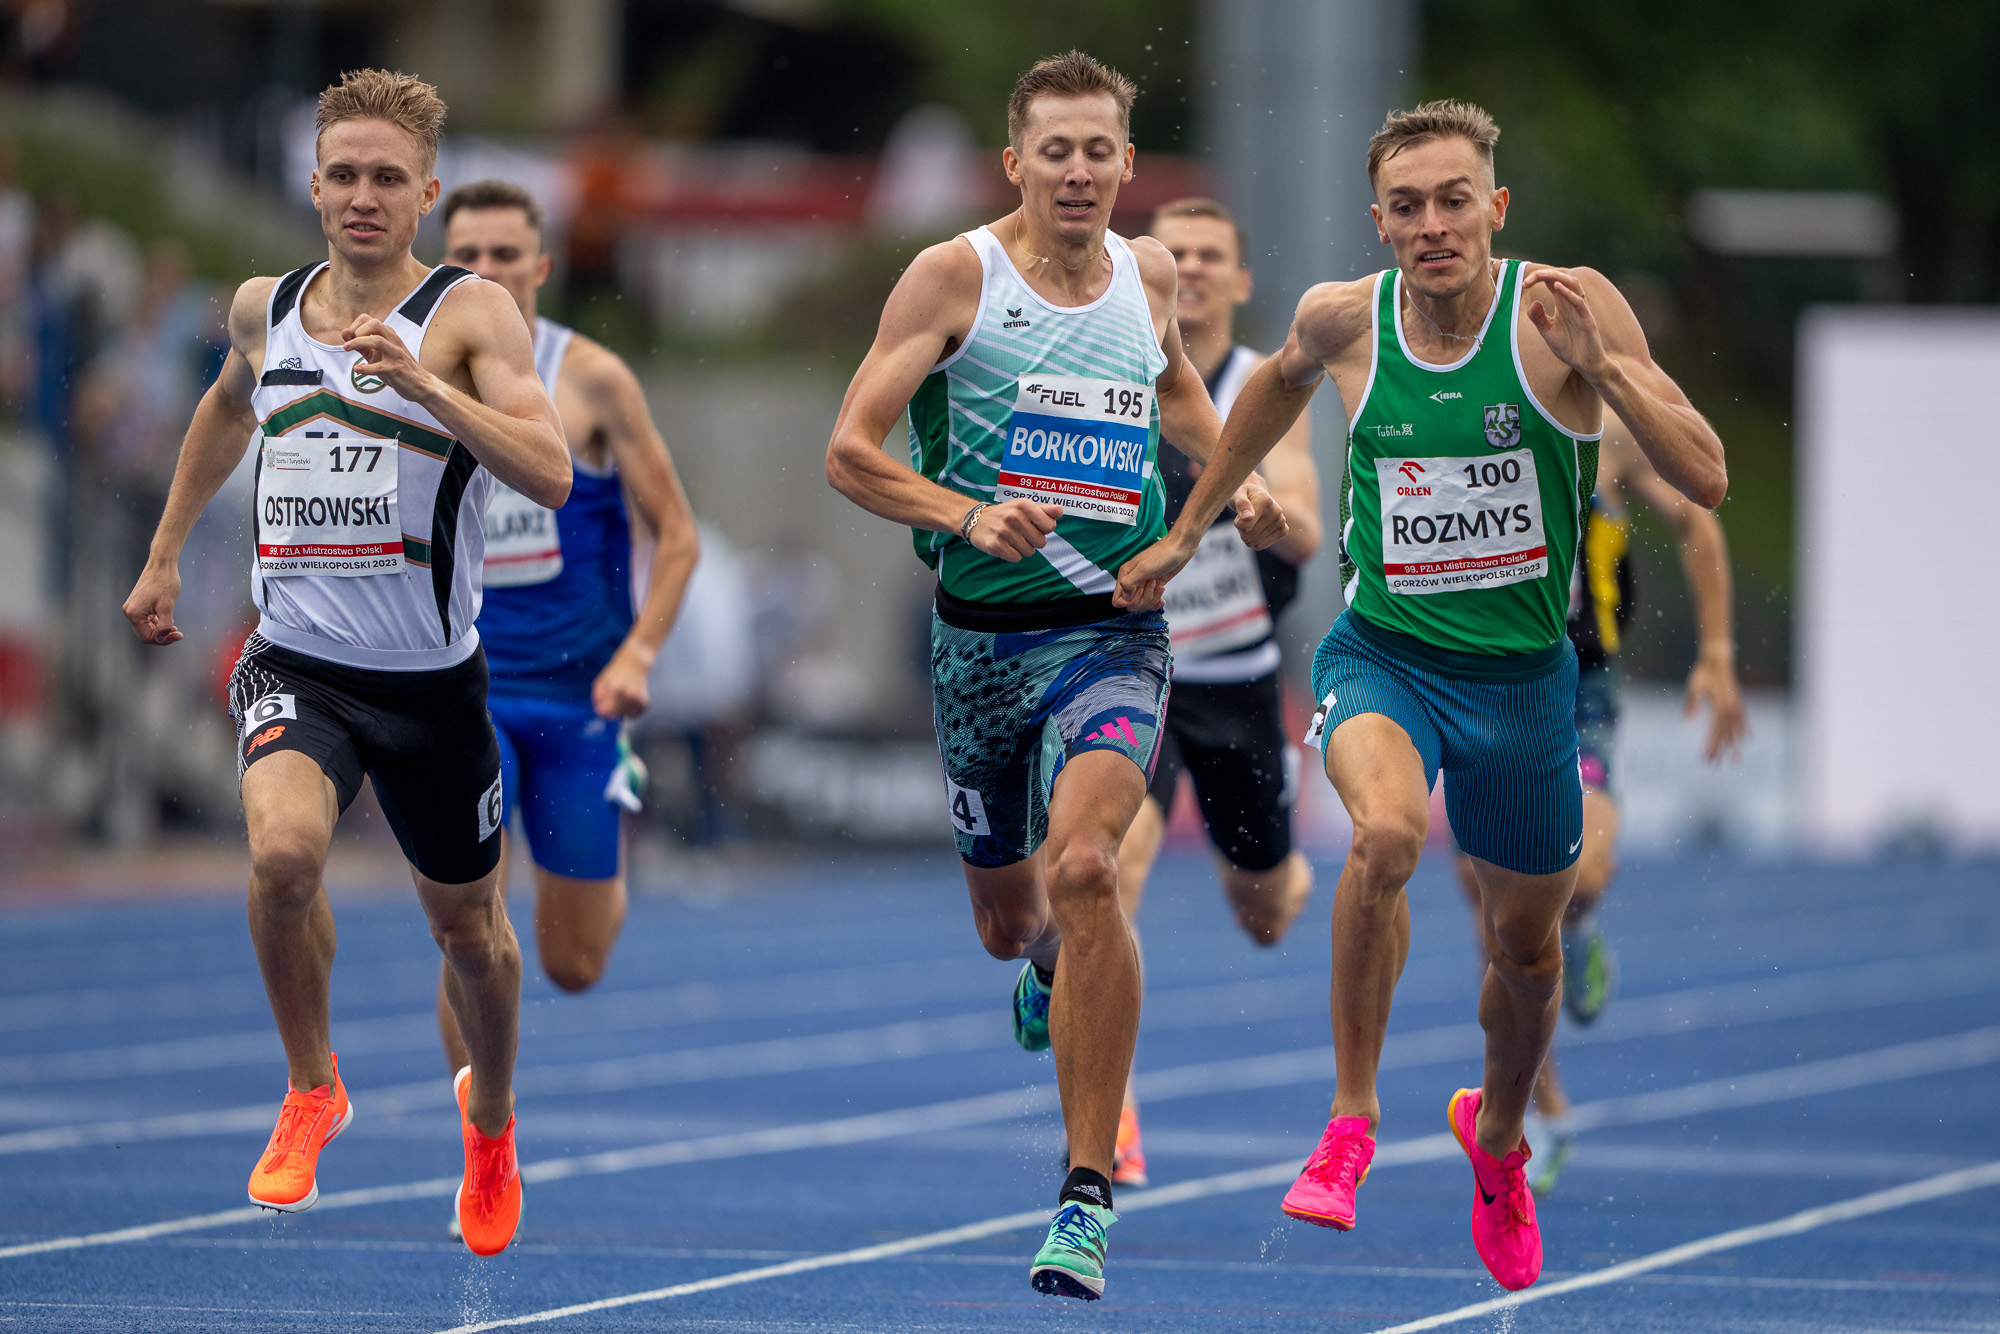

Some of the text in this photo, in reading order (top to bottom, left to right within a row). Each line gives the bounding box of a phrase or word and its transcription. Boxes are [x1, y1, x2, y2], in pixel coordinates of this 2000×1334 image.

[1003, 320, 1030, 328] erima
[1103, 388, 1143, 418] 195
[329, 446, 382, 472] 177
[1010, 427, 1143, 474] BORKOWSKI
[1463, 459, 1520, 488] 100
[1020, 478, 1129, 501] 99. PZLA Mistrzostwa Polski
[1397, 487, 1431, 496] ORLEN
[265, 496, 391, 526] OSTROWSKI
[1052, 497, 1118, 514] WIELKOPOLSKI
[1119, 507, 1135, 517] 2023
[484, 509, 547, 541] LARZ
[1392, 504, 1531, 544] ROZMYS
[269, 545, 383, 555] 99. PZLA Mistrzostwa Polski
[300, 560, 371, 570] WIELKOPOLSKI
[372, 558, 398, 568] 2023
[1393, 563, 1541, 588] GORZÓW WIELKOPOLSKI 2023
[1404, 553, 1528, 574] 99. PZLA Mistrzostwa Polski
[254, 695, 283, 722] 6
[488, 783, 501, 827] 6
[953, 790, 978, 831] 4
